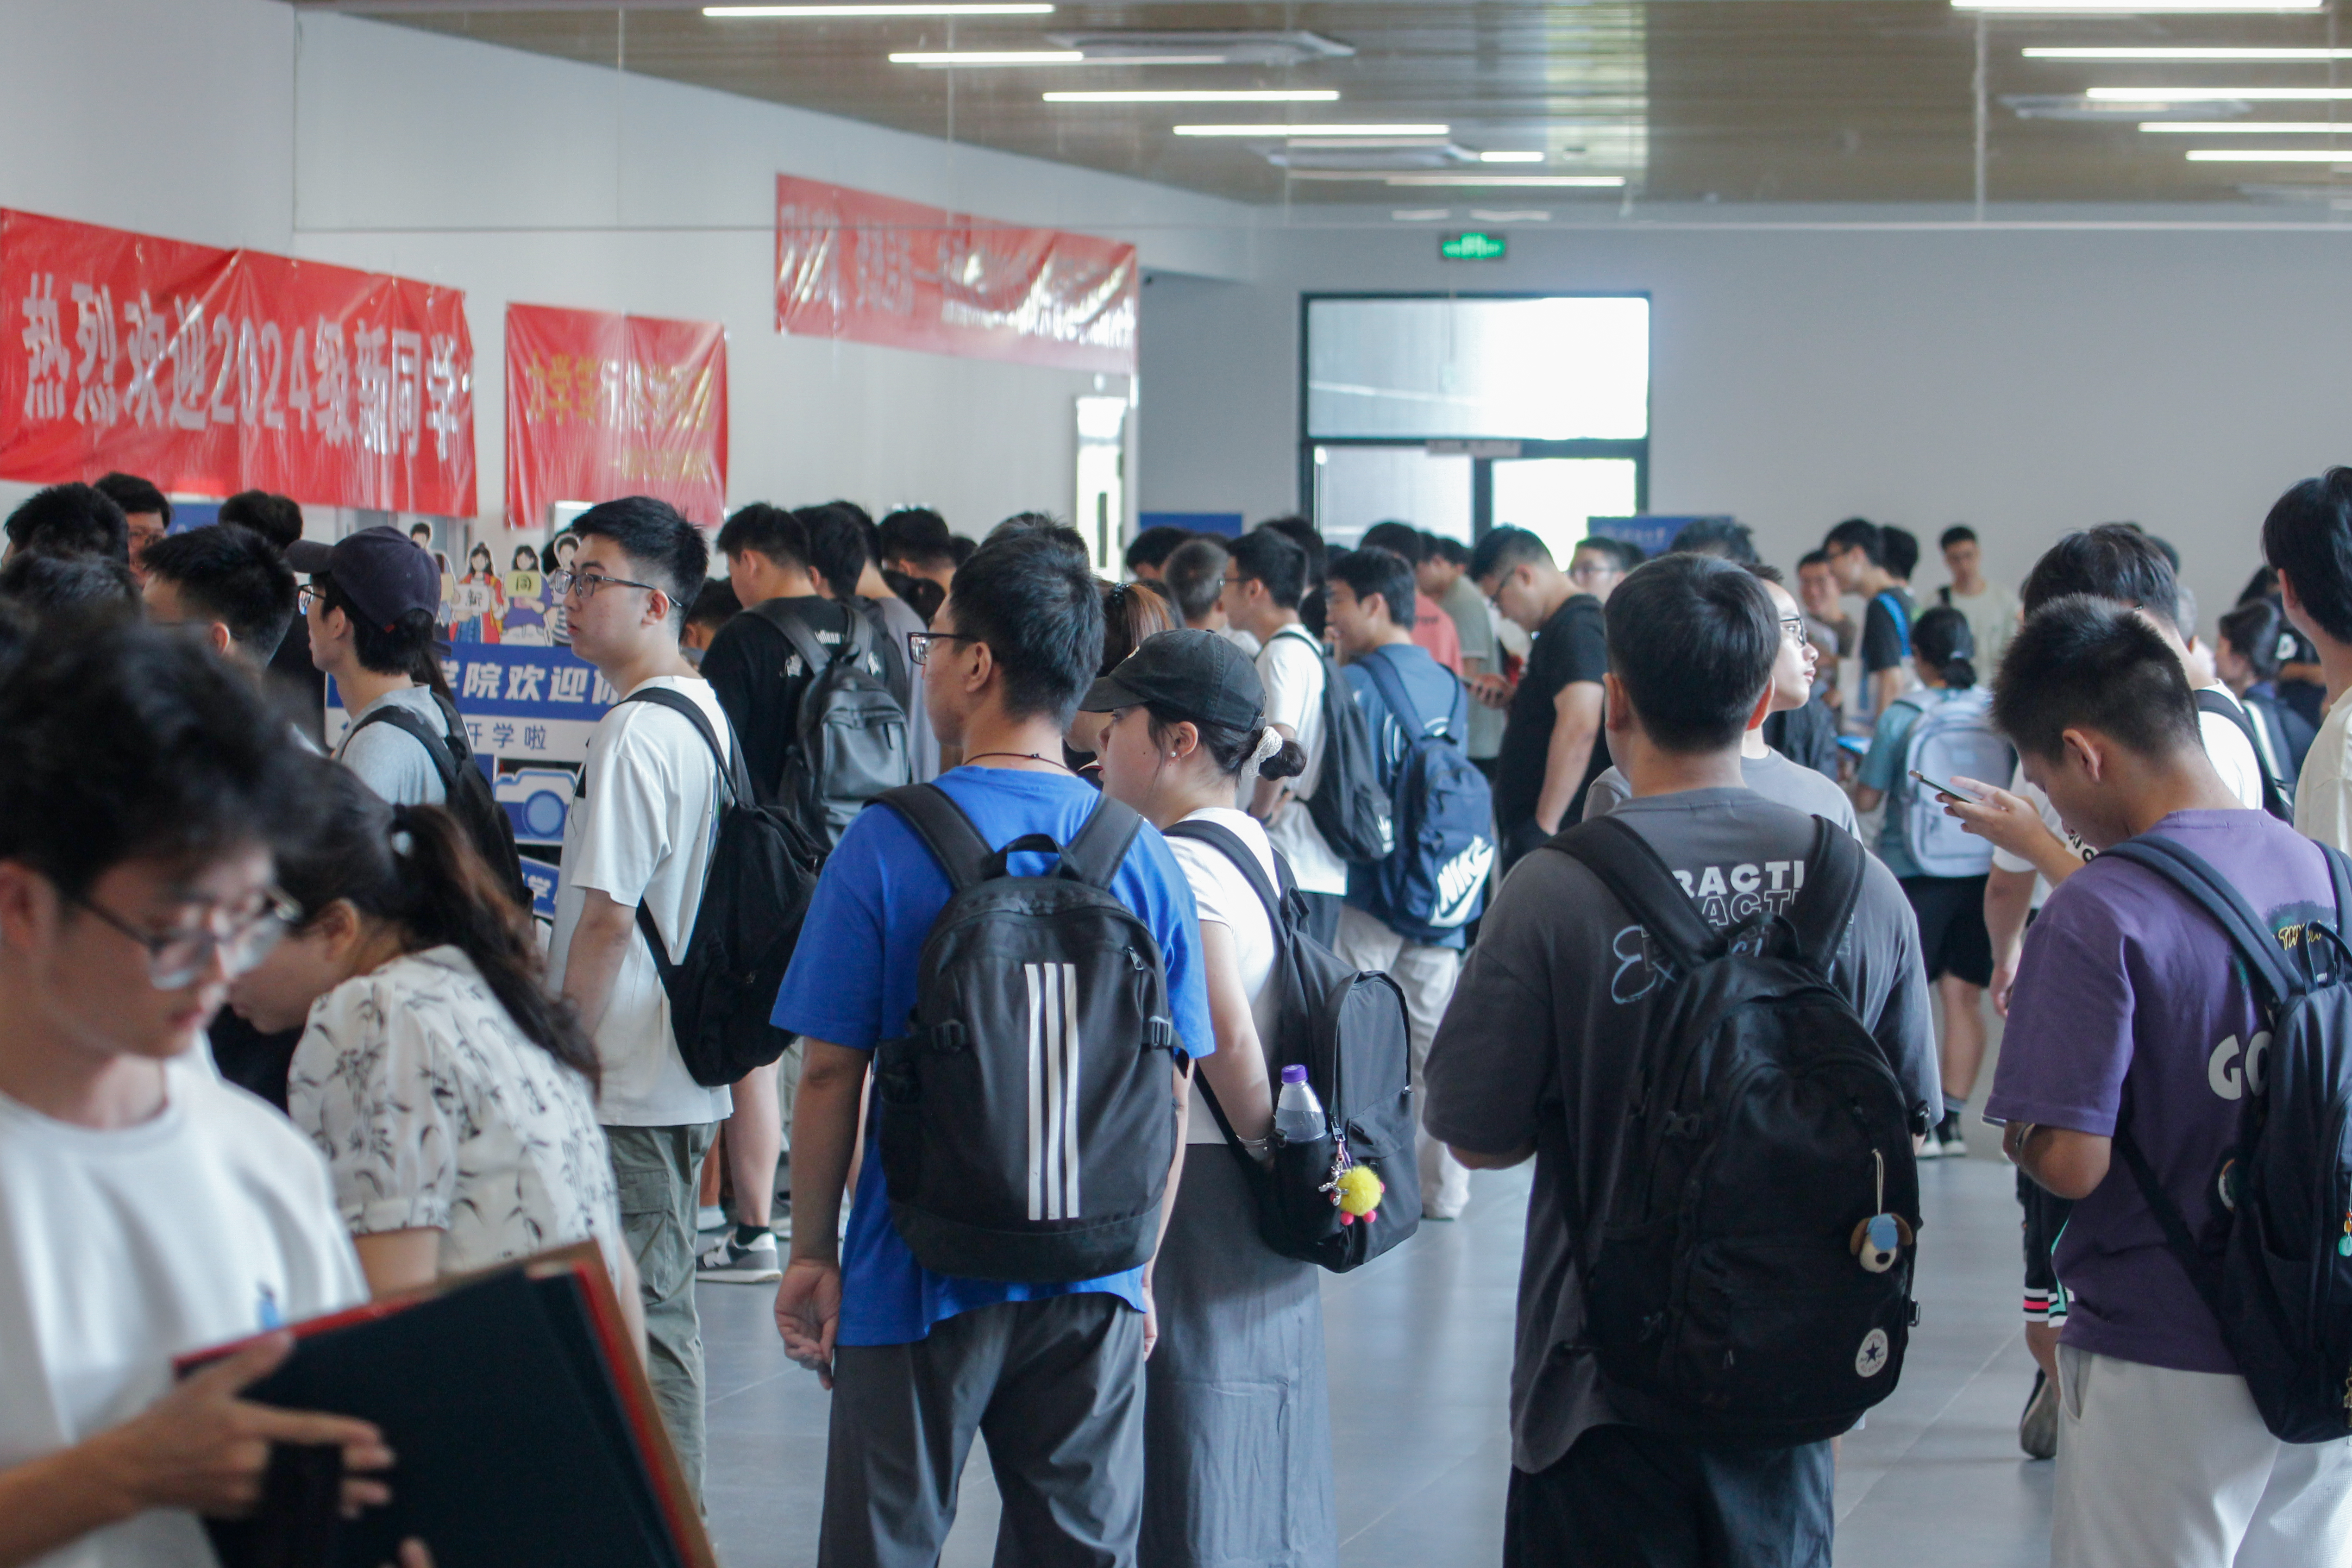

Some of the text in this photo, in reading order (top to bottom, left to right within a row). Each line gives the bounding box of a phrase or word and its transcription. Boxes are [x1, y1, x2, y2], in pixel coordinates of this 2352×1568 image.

[22, 272, 459, 462] 热烈欢迎2024级新同学
